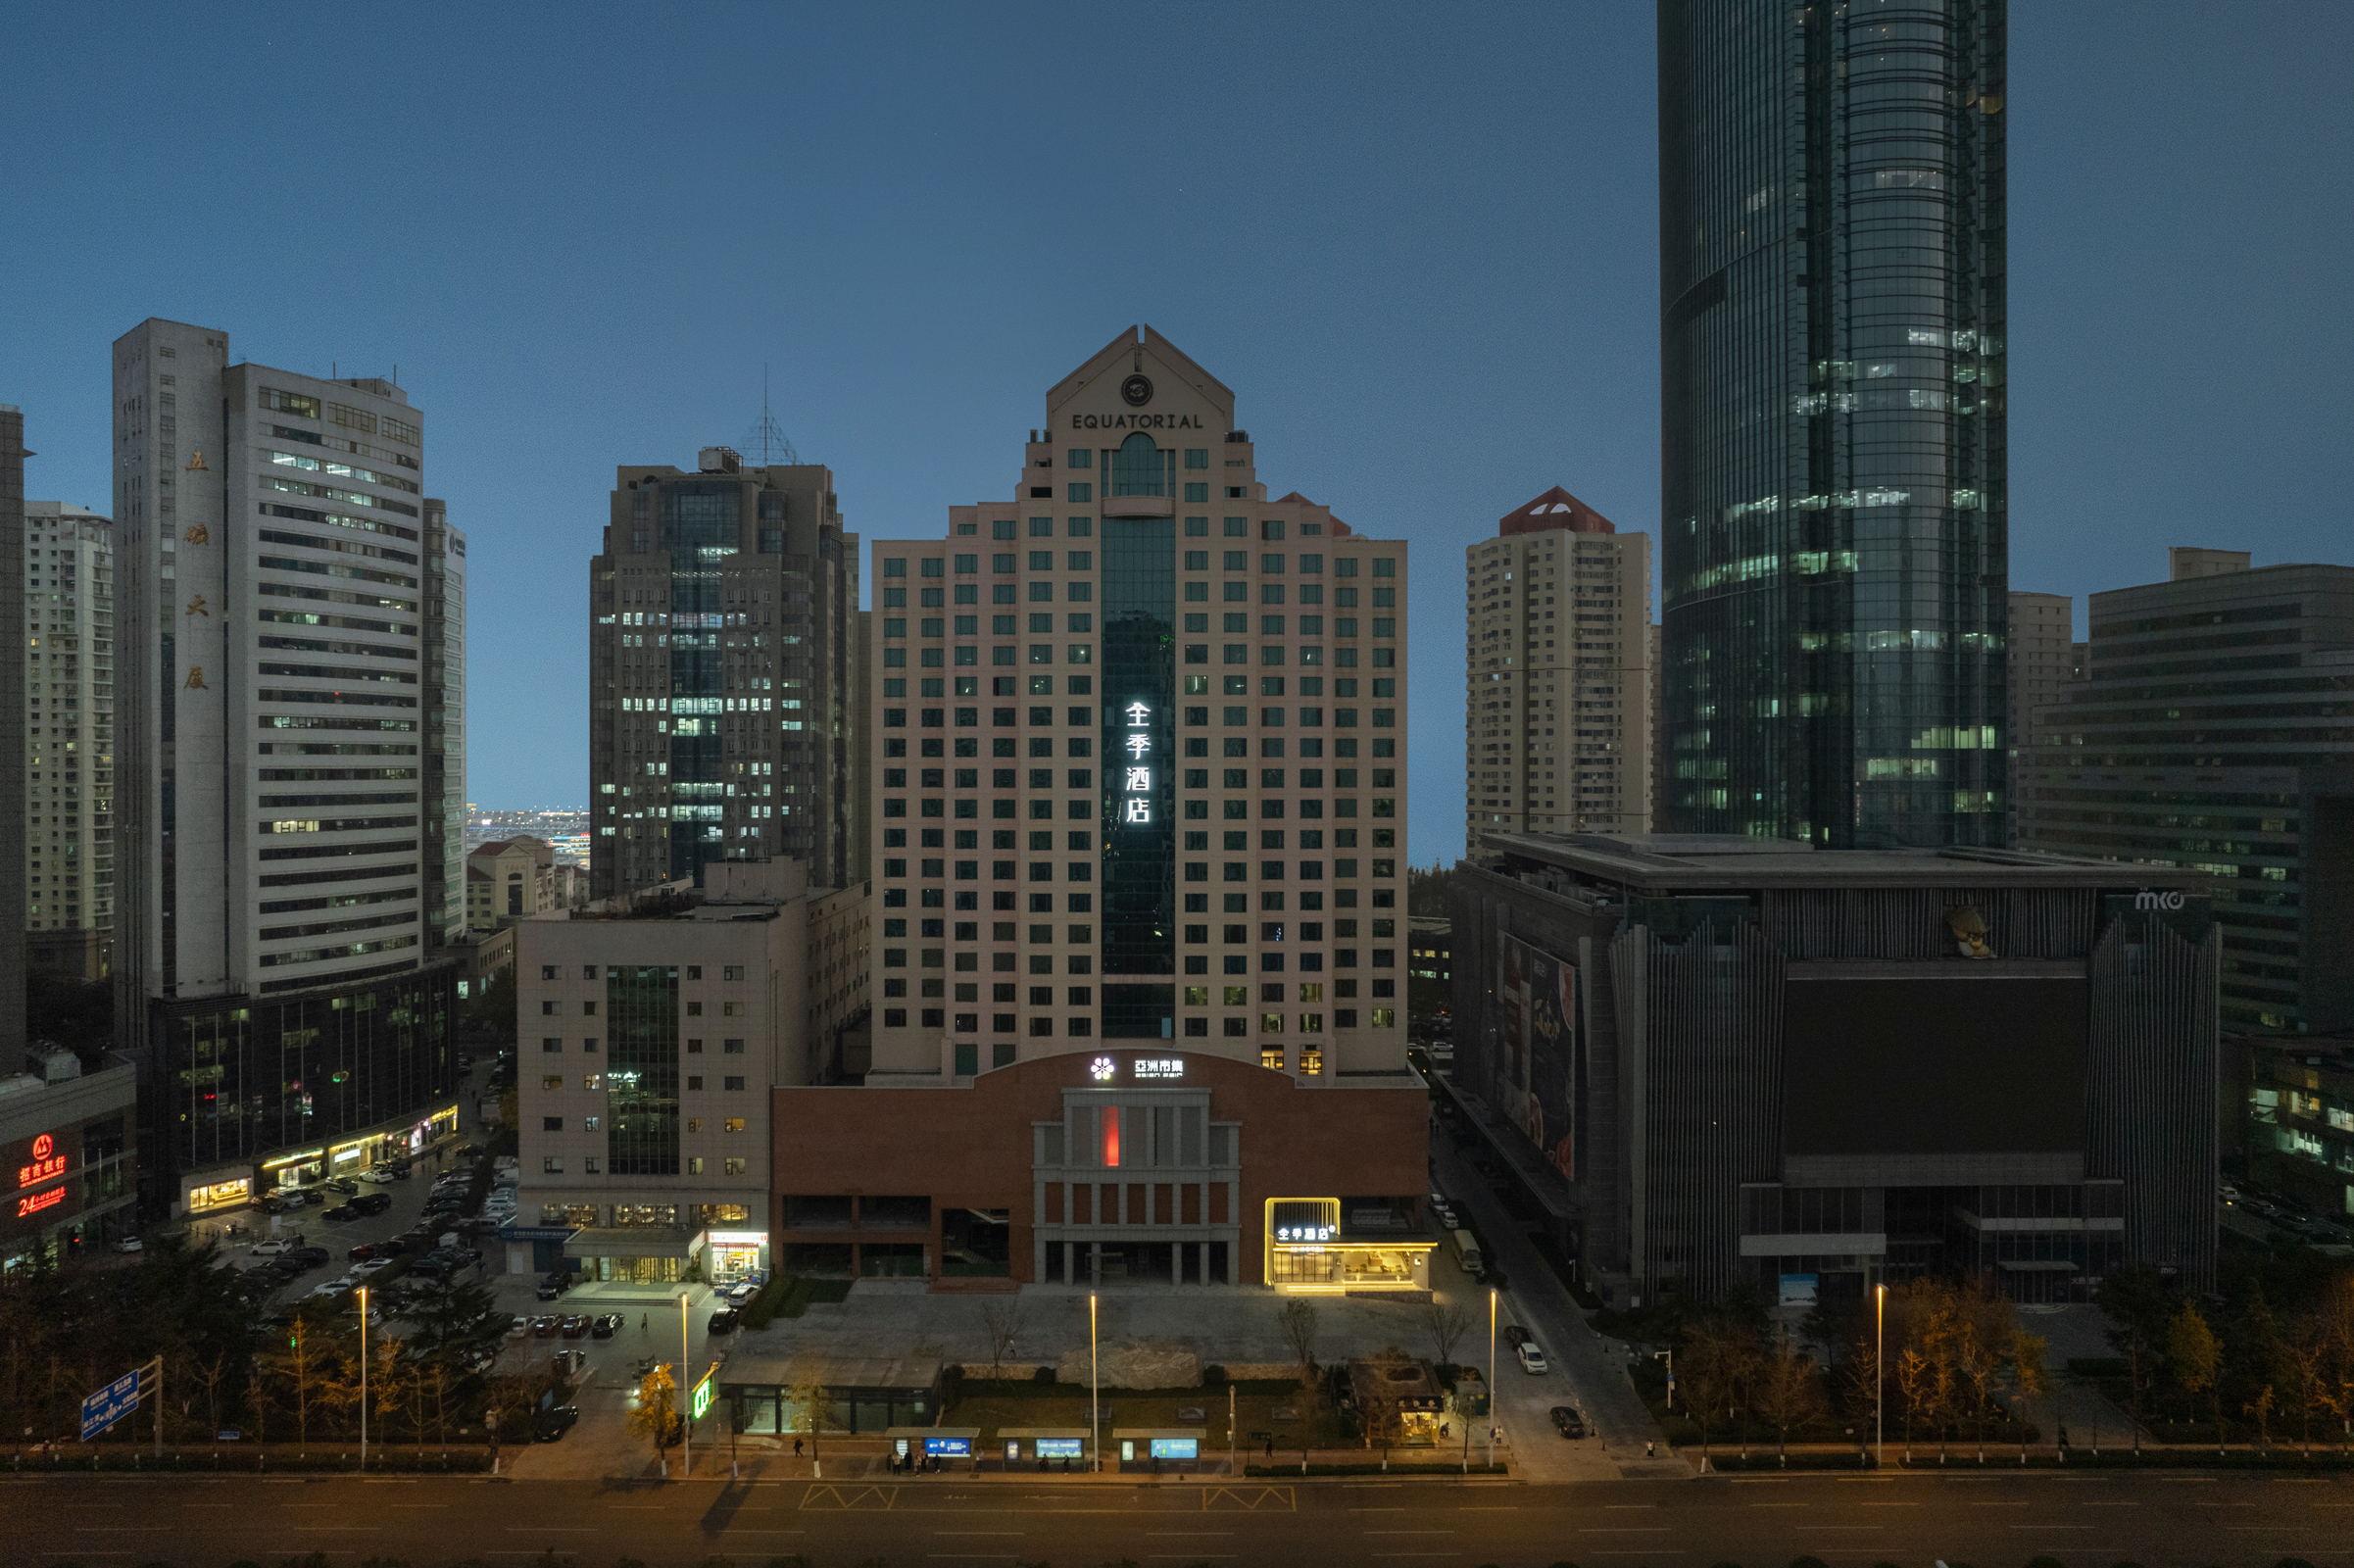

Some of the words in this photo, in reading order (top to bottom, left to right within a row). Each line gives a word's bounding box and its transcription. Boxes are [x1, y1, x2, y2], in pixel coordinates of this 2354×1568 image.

[1072, 414, 1203, 429] EQUATORIAL
[1125, 702, 1152, 822] 全季酒店
[1135, 1059, 1183, 1072] 亞洲市集
[19, 1154, 66, 1183] 招商银行
[1278, 1227, 1329, 1241] 全季酒店
